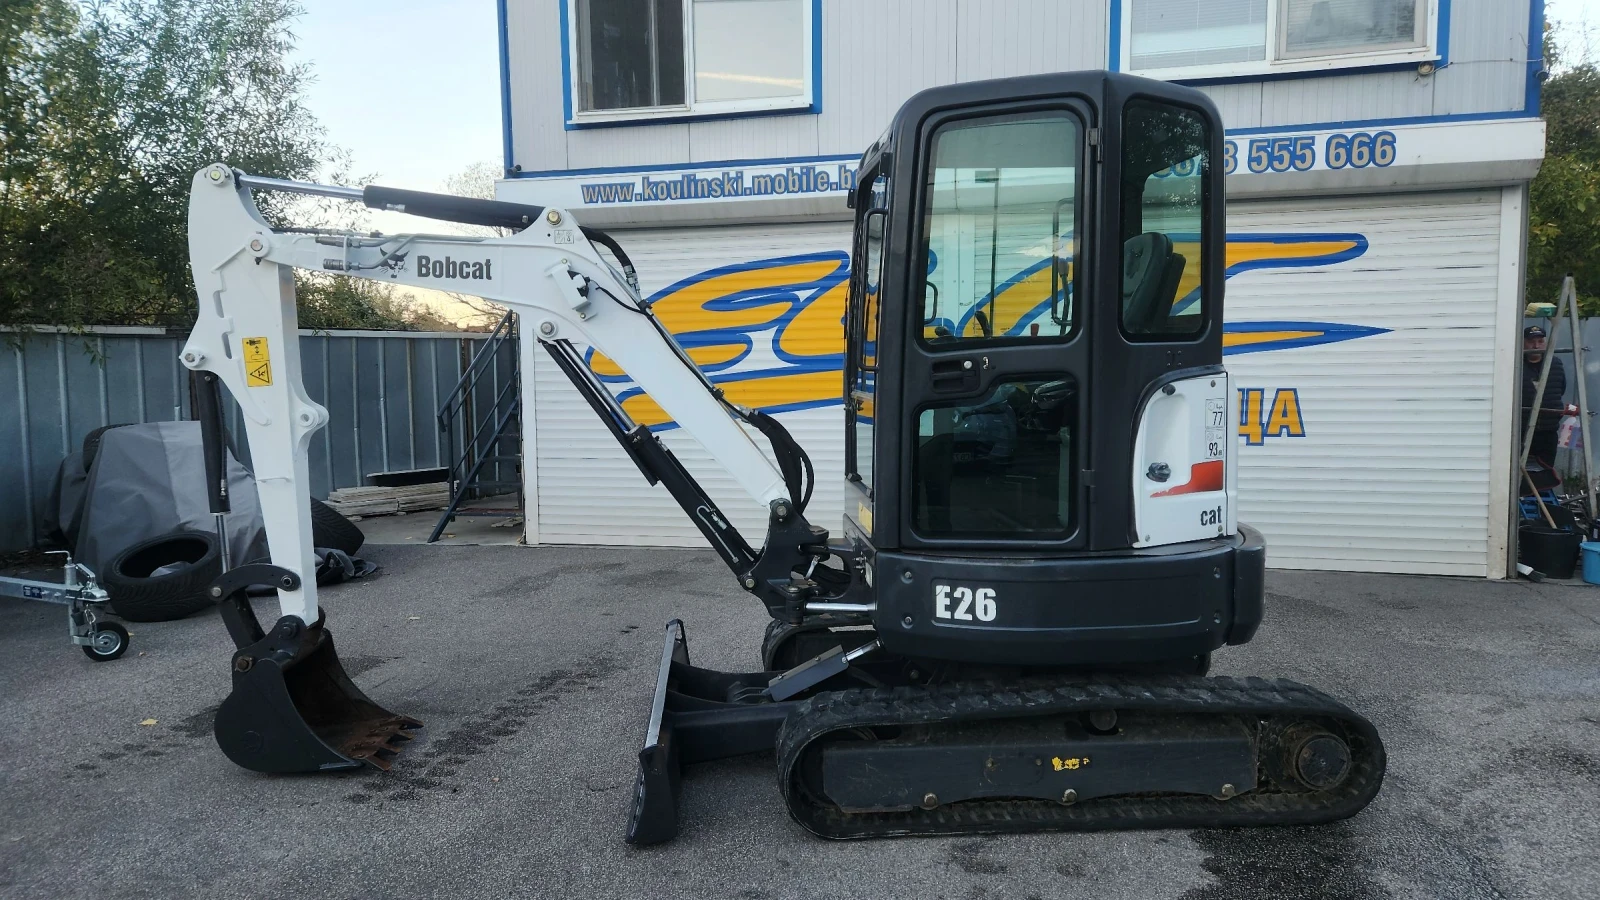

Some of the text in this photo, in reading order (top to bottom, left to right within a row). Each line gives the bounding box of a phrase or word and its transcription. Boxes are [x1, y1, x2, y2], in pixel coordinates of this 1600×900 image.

[1248, 136, 1316, 174] 555
[1325, 131, 1396, 169] 666
[581, 164, 859, 204] www.koulinski.mobile.b
[417, 255, 492, 280] Bobcat
[1212, 411, 1223, 426] 77
[1208, 442, 1218, 457] 93
[1200, 505, 1222, 526] cat
[935, 585, 997, 622] E26
